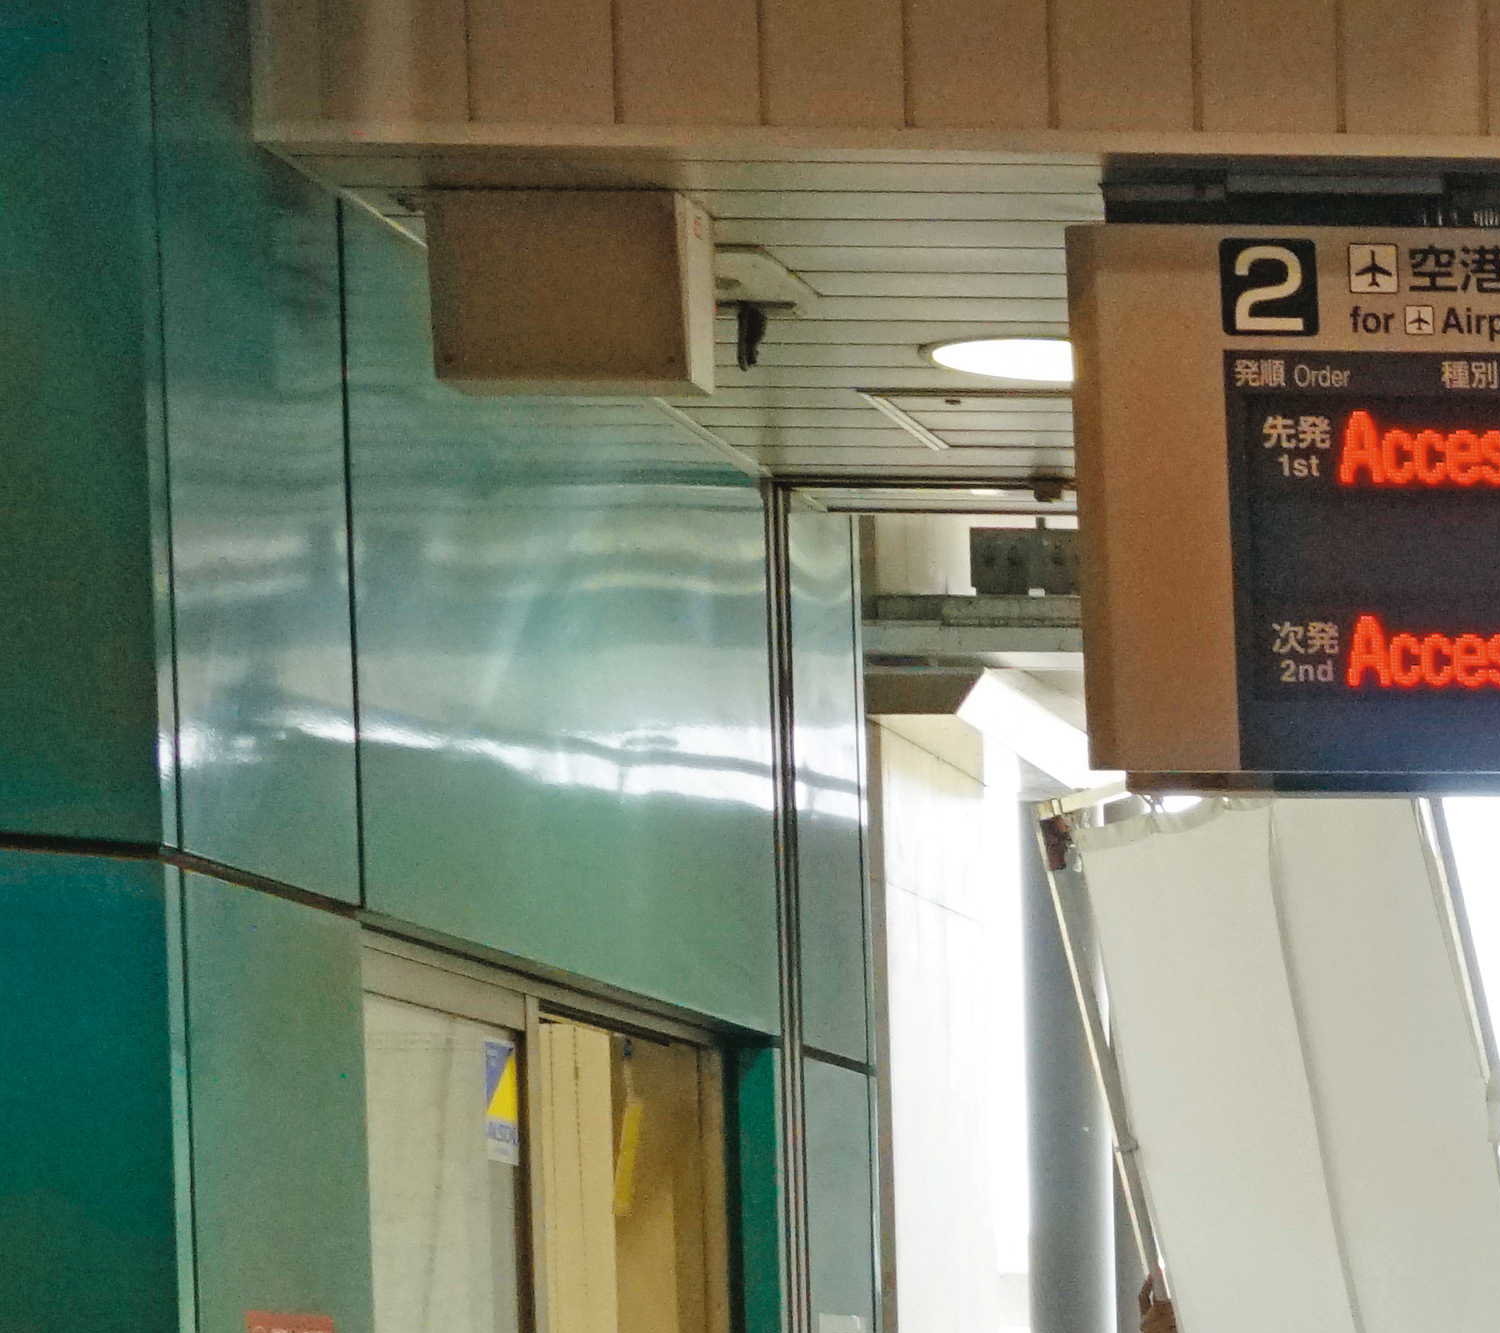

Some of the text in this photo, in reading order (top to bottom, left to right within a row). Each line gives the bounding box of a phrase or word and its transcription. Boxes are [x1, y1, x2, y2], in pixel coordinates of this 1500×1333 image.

[1234, 246, 1304, 332] 2
[1350, 307, 1395, 334] for
[1234, 361, 1350, 389] 発順 Order
[1441, 361, 1498, 390] 種別
[1263, 415, 1330, 449] 先発
[1279, 455, 1320, 478] 1st
[1271, 621, 1338, 655] 次発
[1280, 659, 1335, 682] 2nd
